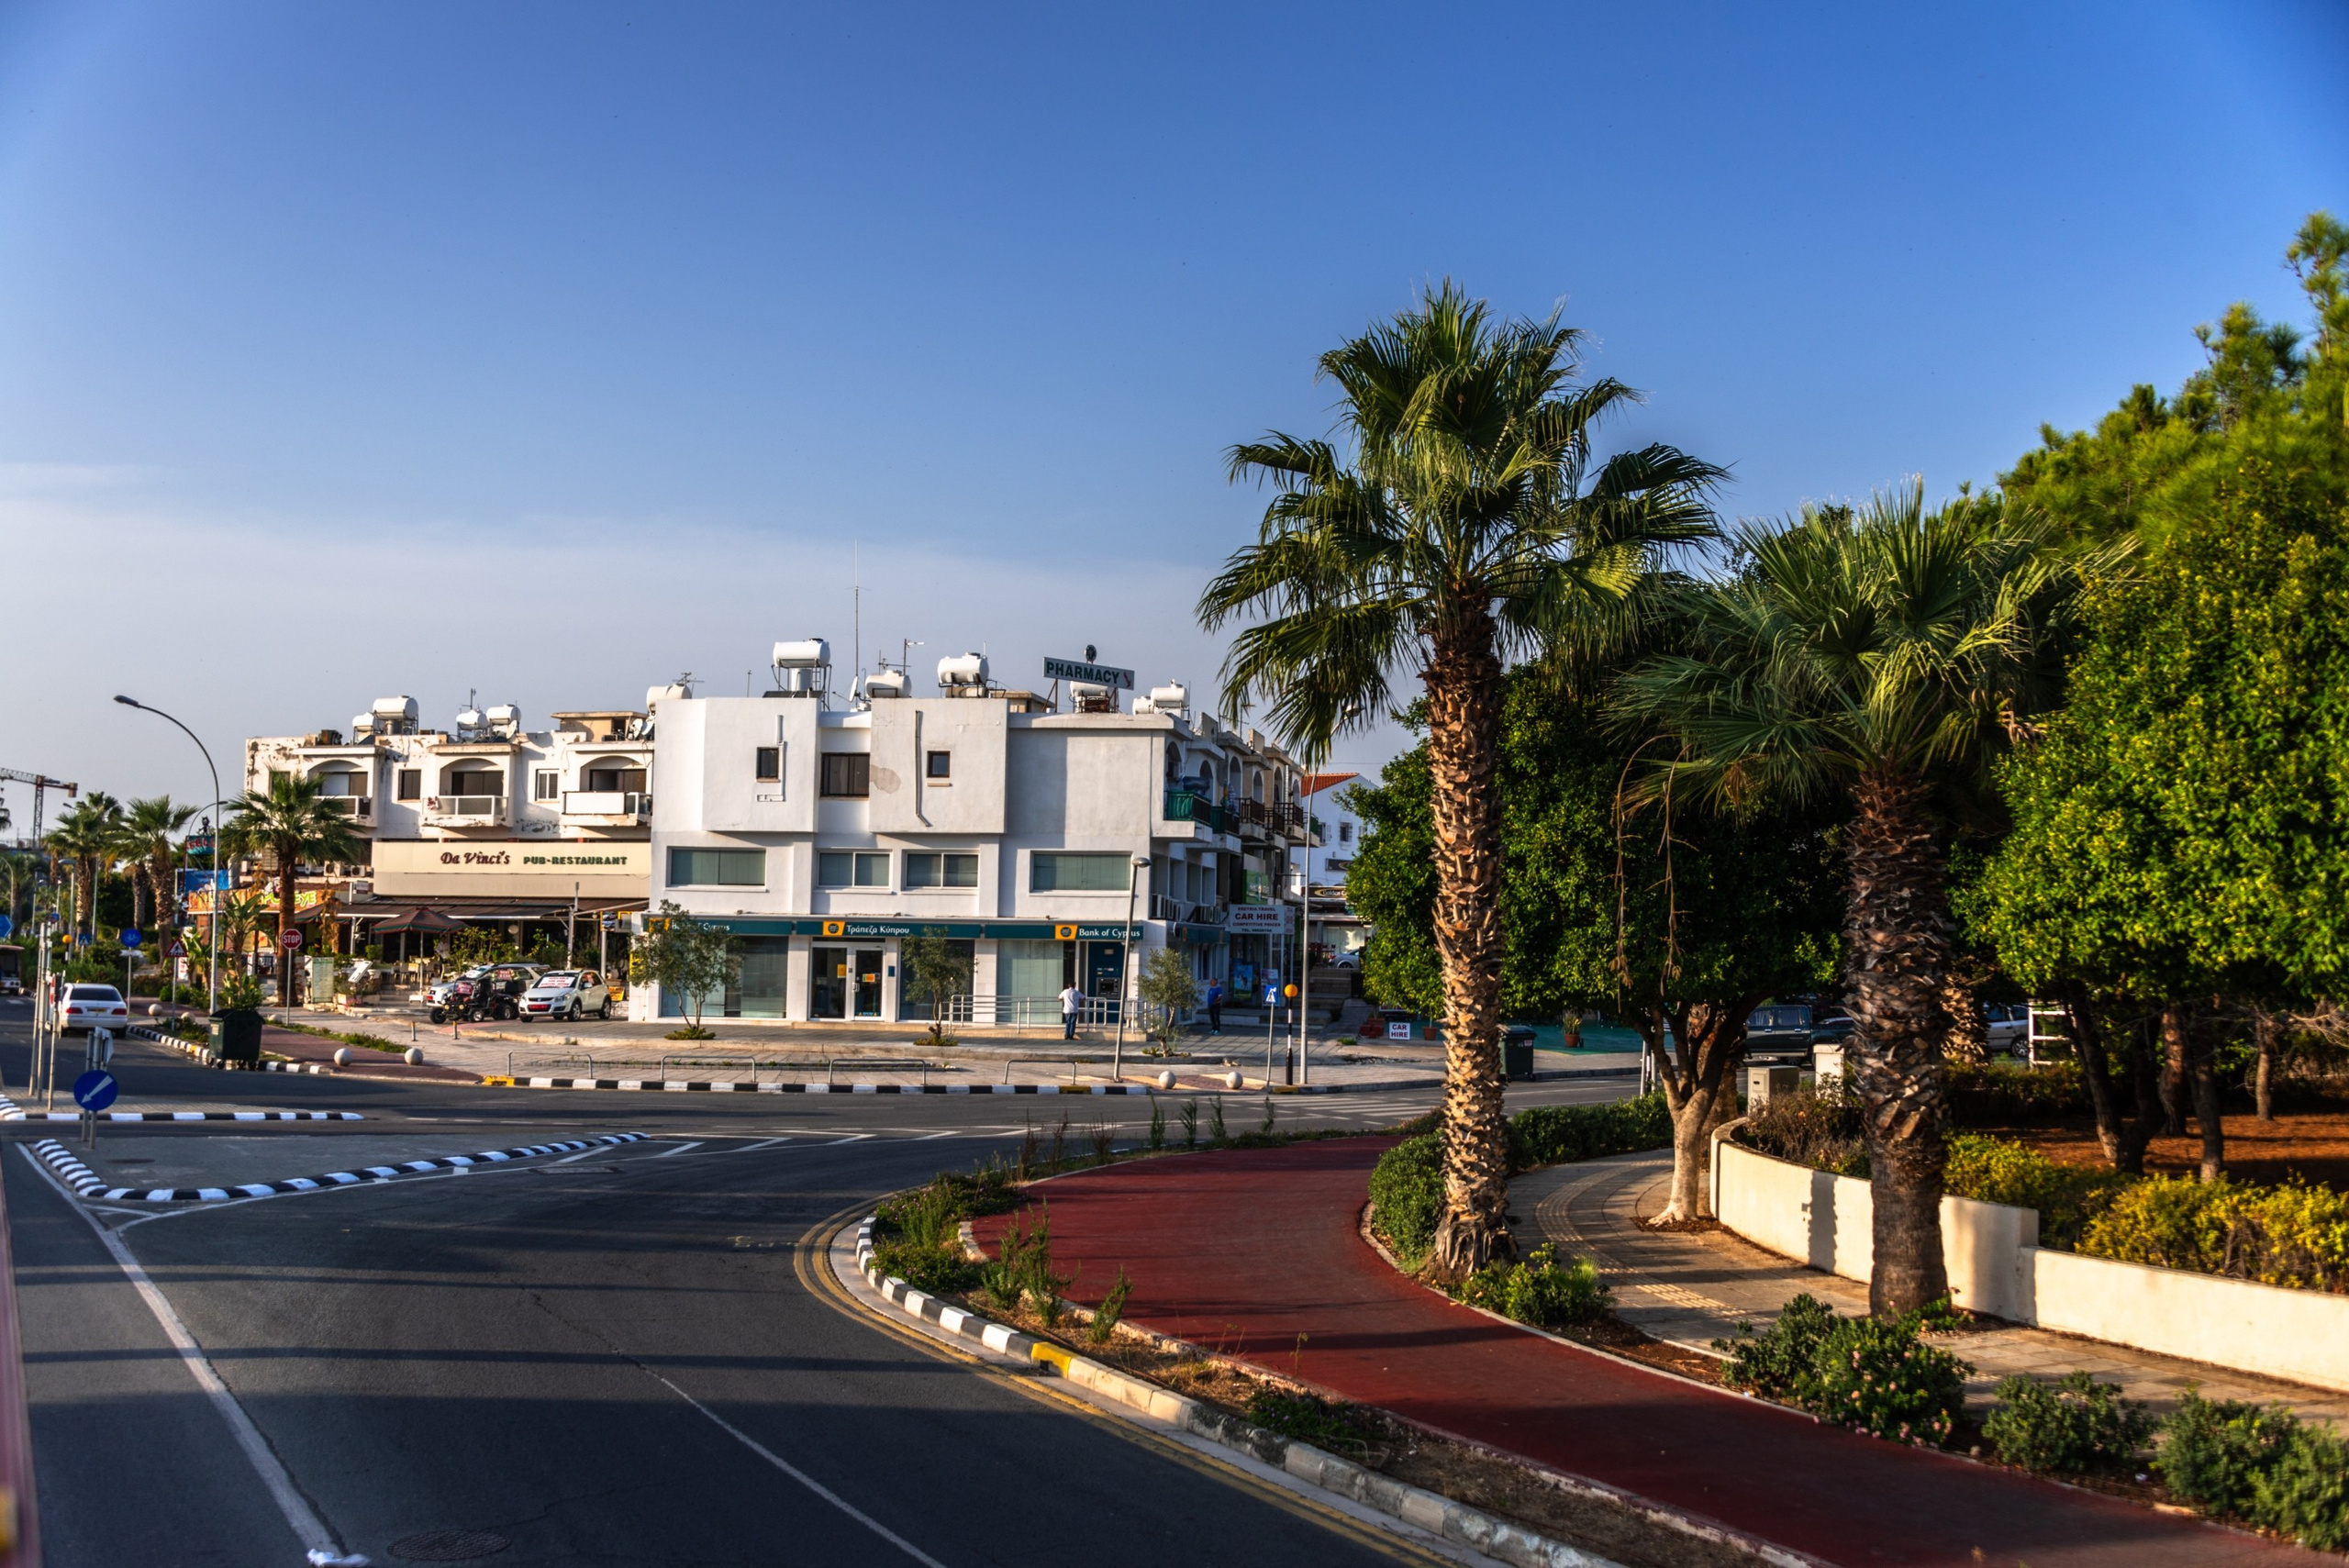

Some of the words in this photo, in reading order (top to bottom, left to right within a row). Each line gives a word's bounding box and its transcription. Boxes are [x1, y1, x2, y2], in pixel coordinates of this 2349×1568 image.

[1046, 662, 1120, 684] PHARMACY
[440, 851, 461, 865] Da
[463, 851, 511, 865] Vinci's
[523, 856, 628, 865] PUB-RESTAURANT
[261, 891, 317, 907] POEYE
[846, 925, 878, 936] Τράπεζα
[880, 926, 910, 936] Κύπρου
[1079, 929, 1099, 937] Bank
[1112, 929, 1141, 939] Cypus
[283, 935, 301, 944] STOP
